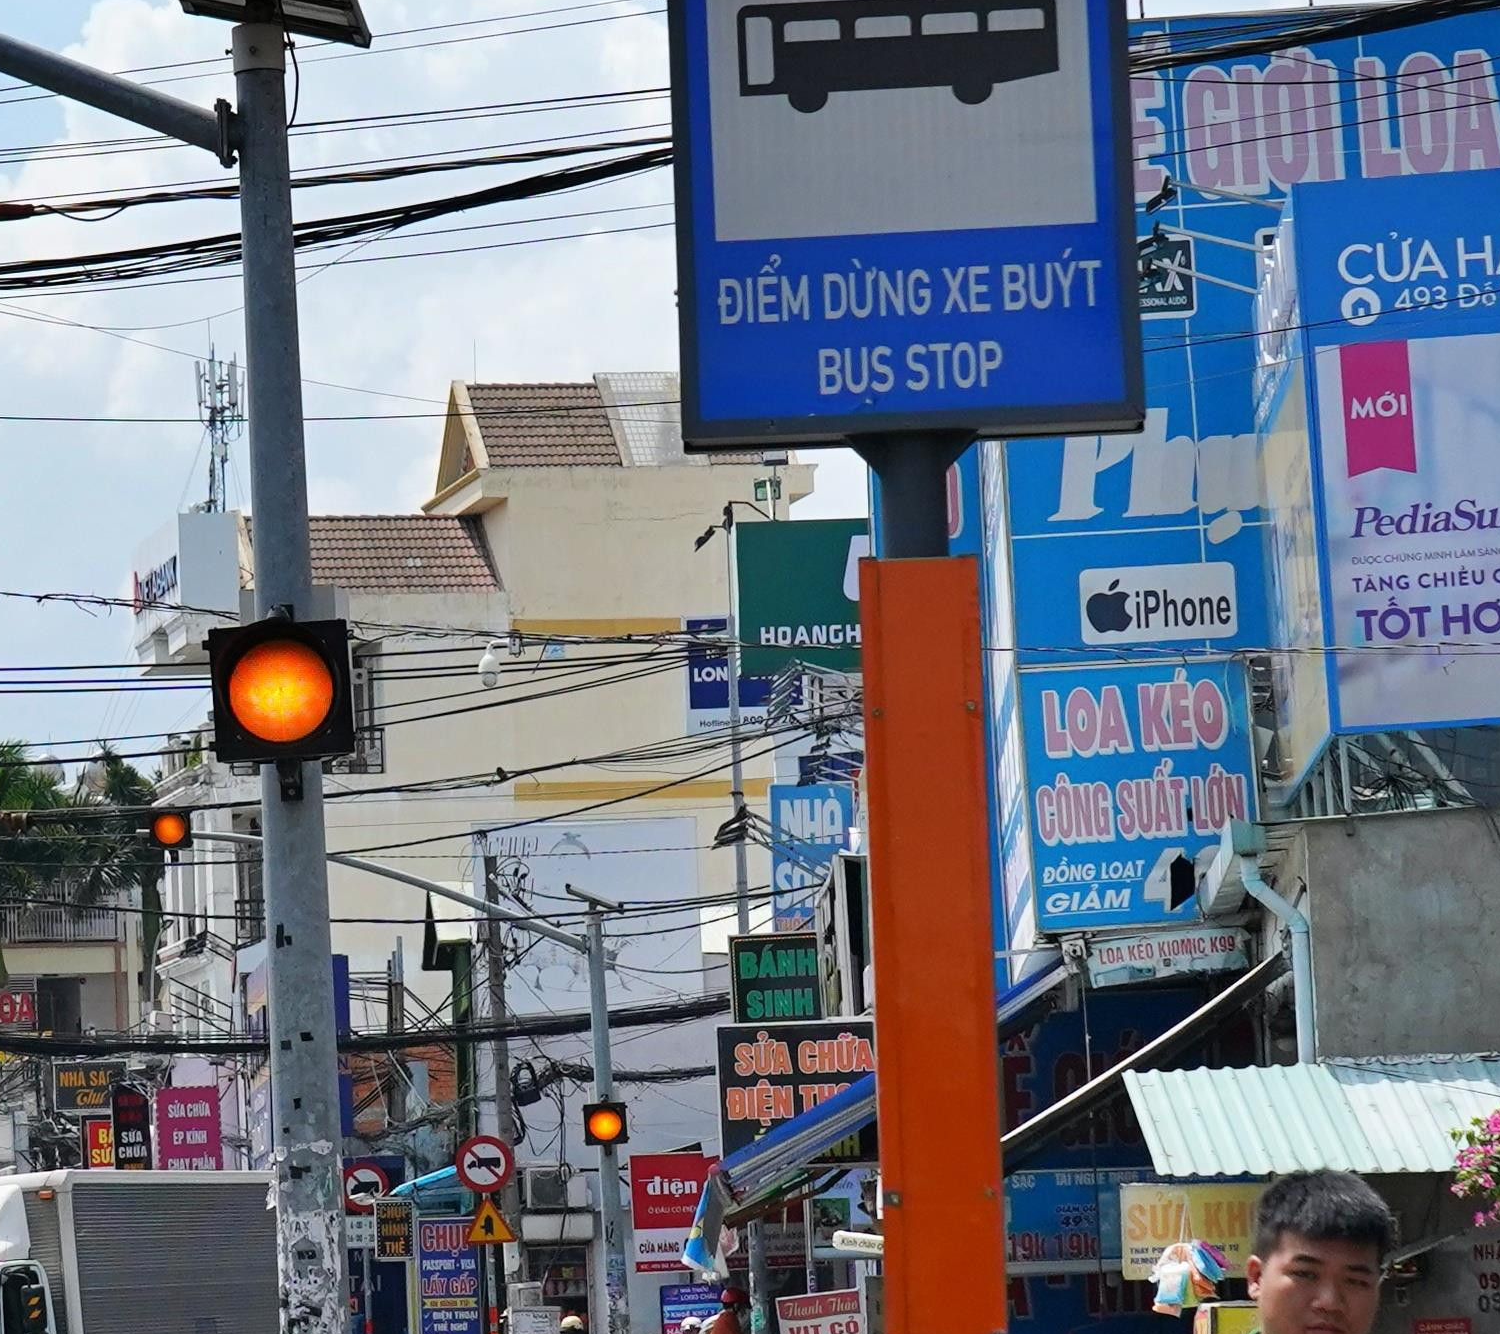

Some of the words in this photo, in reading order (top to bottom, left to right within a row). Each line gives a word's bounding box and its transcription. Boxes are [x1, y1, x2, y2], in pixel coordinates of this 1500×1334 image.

[1337, 232, 1448, 288] CỬA
[718, 254, 810, 326] ĐIỂM
[823, 252, 932, 320] DỪNG
[943, 265, 989, 315] XE
[1001, 247, 1102, 313] BUÝT
[1394, 283, 1448, 314] 493
[818, 346, 894, 396] BUS
[905, 340, 1004, 392] STOP
[1350, 392, 1408, 419] MỚI
[1424, 549, 1452, 561] MINH
[1352, 572, 1411, 594] TĂNG
[1418, 565, 1486, 589] CHIỀU
[1134, 587, 1232, 630] iPhone
[1356, 595, 1432, 642] TỐT
[1041, 685, 1134, 759] LOA
[1137, 668, 1231, 751] KÉO
[779, 787, 845, 848] NHÀ
[1036, 773, 1114, 846] CÔNG
[1116, 759, 1190, 841] SUẤT
[1189, 762, 1248, 837] LỚN
[1042, 855, 1097, 883] ĐỒNG
[1100, 857, 1145, 884] LOẠT
[1044, 883, 1131, 914] GIẢM
[739, 944, 817, 980] BÁNH
[1099, 946, 1123, 966] LOA
[1125, 940, 1157, 964] KÉO
[1159, 937, 1205, 961] KIOMIC
[1210, 934, 1237, 955] K99
[746, 988, 814, 1018] SINH
[734, 1031, 793, 1077] SỬA
[798, 1032, 876, 1076] CHỮA
[726, 1079, 794, 1126] ĐIỆN
[647, 1175, 698, 1198] điện
[1011, 1173, 1037, 1190] SẠC
[1126, 1189, 1193, 1242] SỬA
[638, 1240, 655, 1255] CỬA
[657, 1240, 680, 1254] HÀNG
[422, 1271, 448, 1297] LẤY
[449, 1270, 478, 1296] GẤP
[784, 1300, 823, 1319] Thanh
